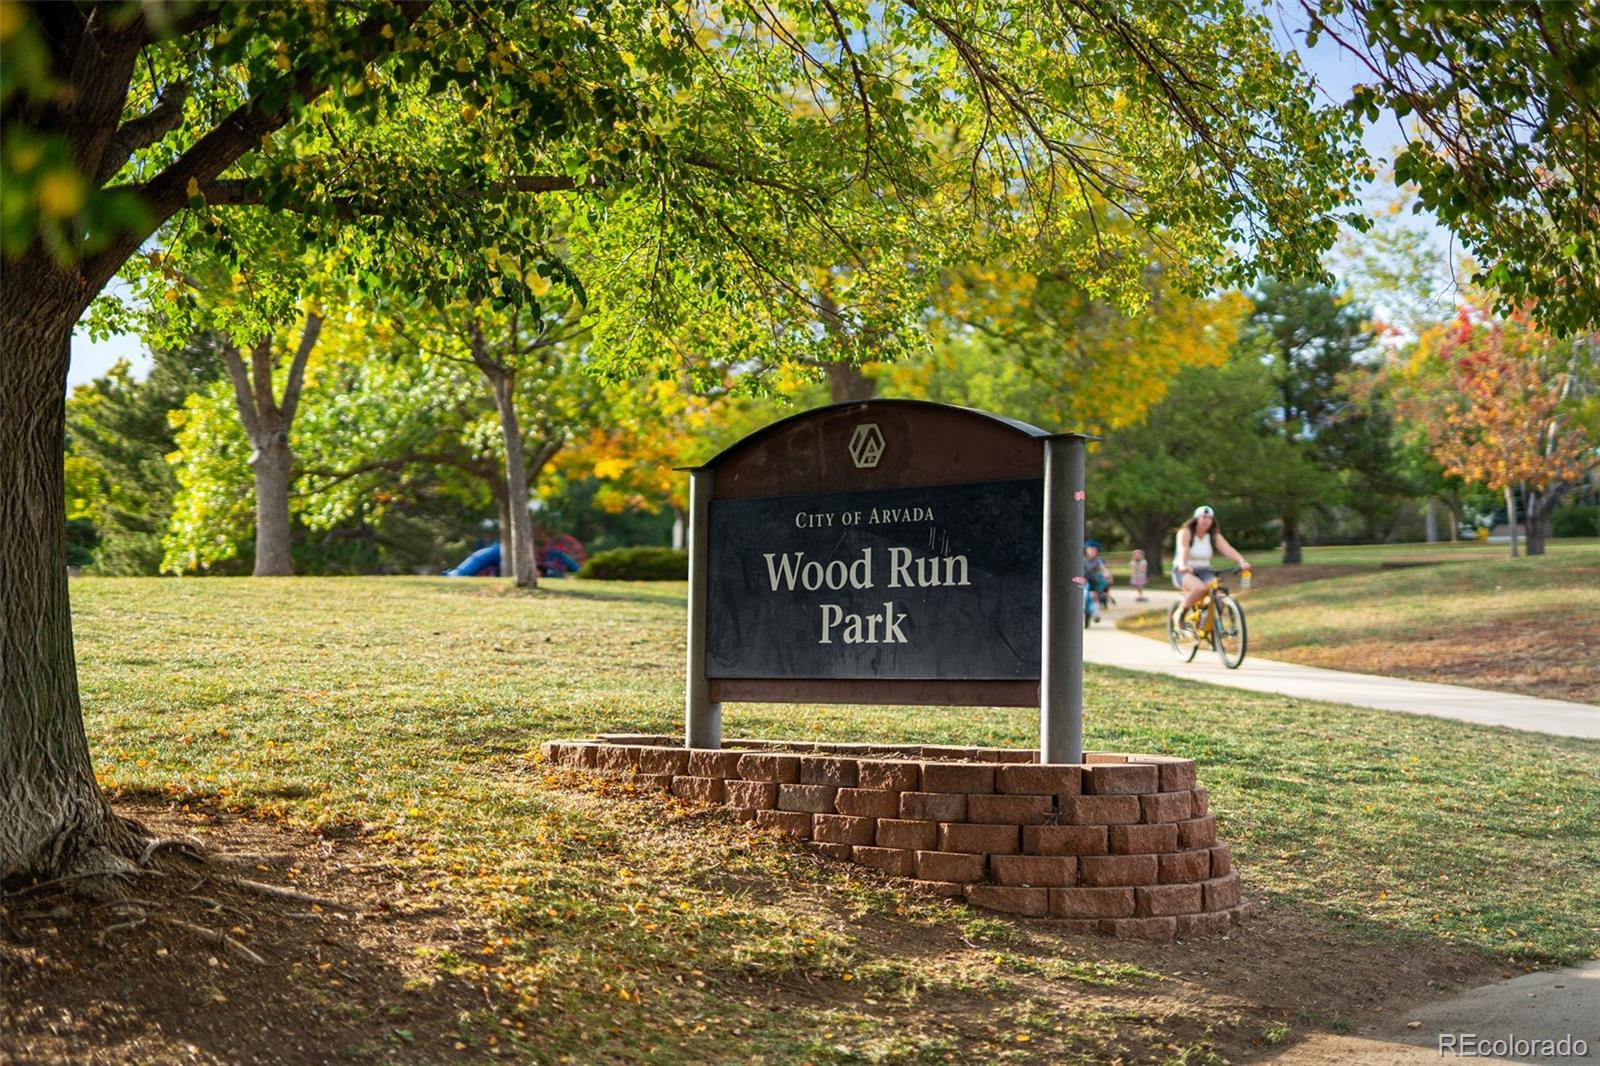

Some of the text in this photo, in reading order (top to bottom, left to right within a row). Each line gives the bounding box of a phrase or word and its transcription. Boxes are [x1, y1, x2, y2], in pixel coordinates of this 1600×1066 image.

[795, 506, 934, 528] CITY OF ARVADA
[764, 547, 971, 592] Wood Run
[818, 601, 908, 645] Park
